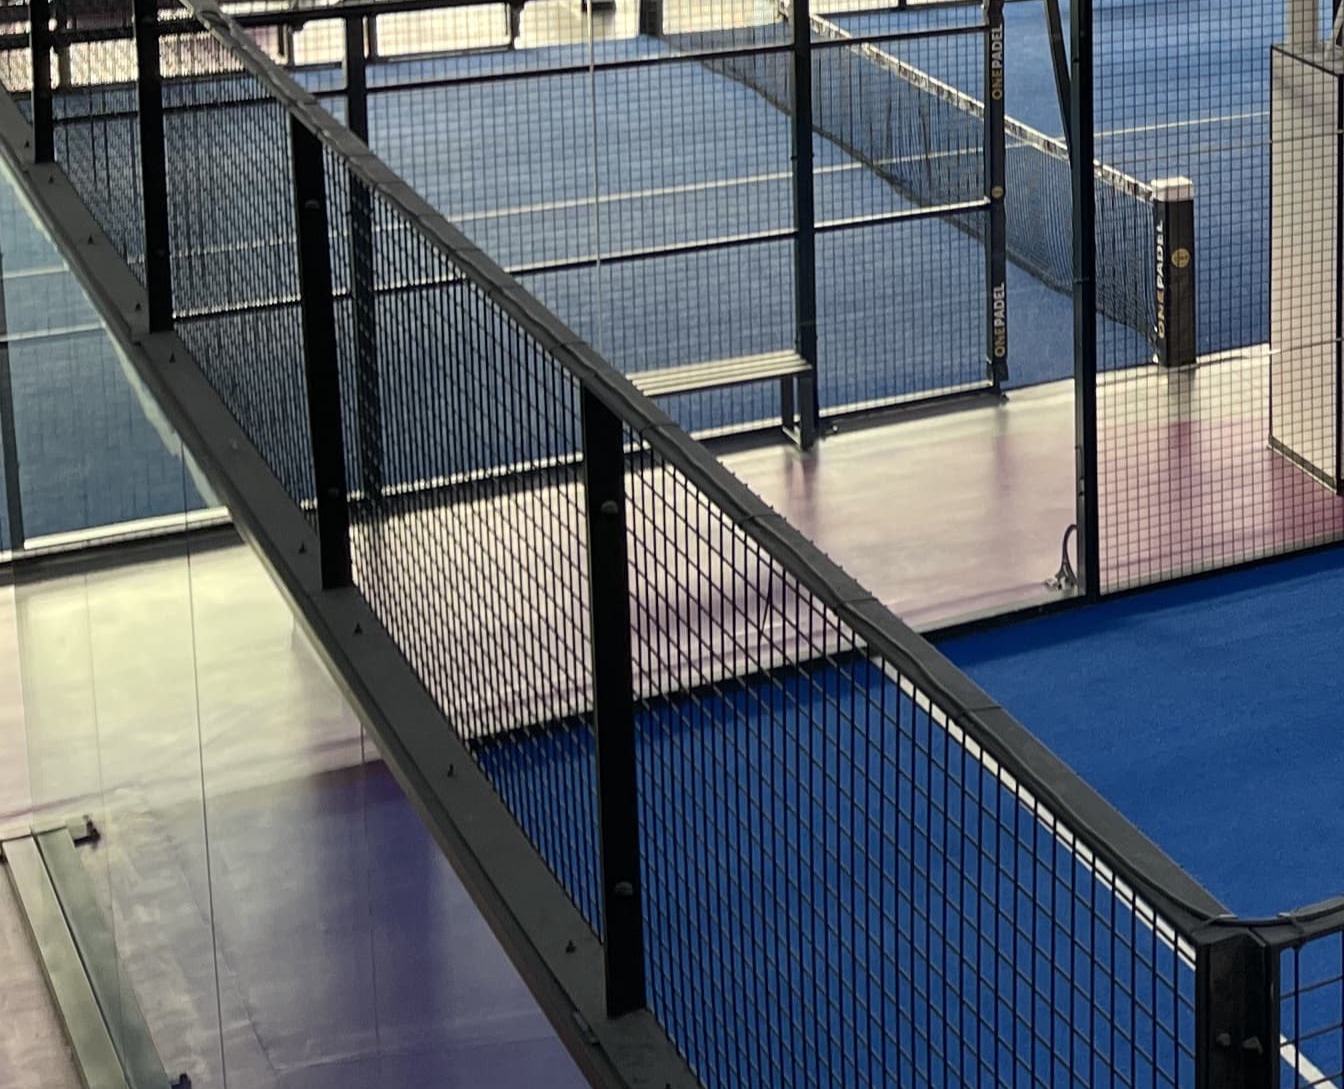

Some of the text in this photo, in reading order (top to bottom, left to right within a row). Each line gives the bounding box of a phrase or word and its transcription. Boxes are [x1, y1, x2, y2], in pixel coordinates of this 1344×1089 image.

[991, 22, 1003, 100] ONEPADEL
[1156, 219, 1165, 339] ONEPADEL
[993, 281, 1006, 358] ONEPADEL
